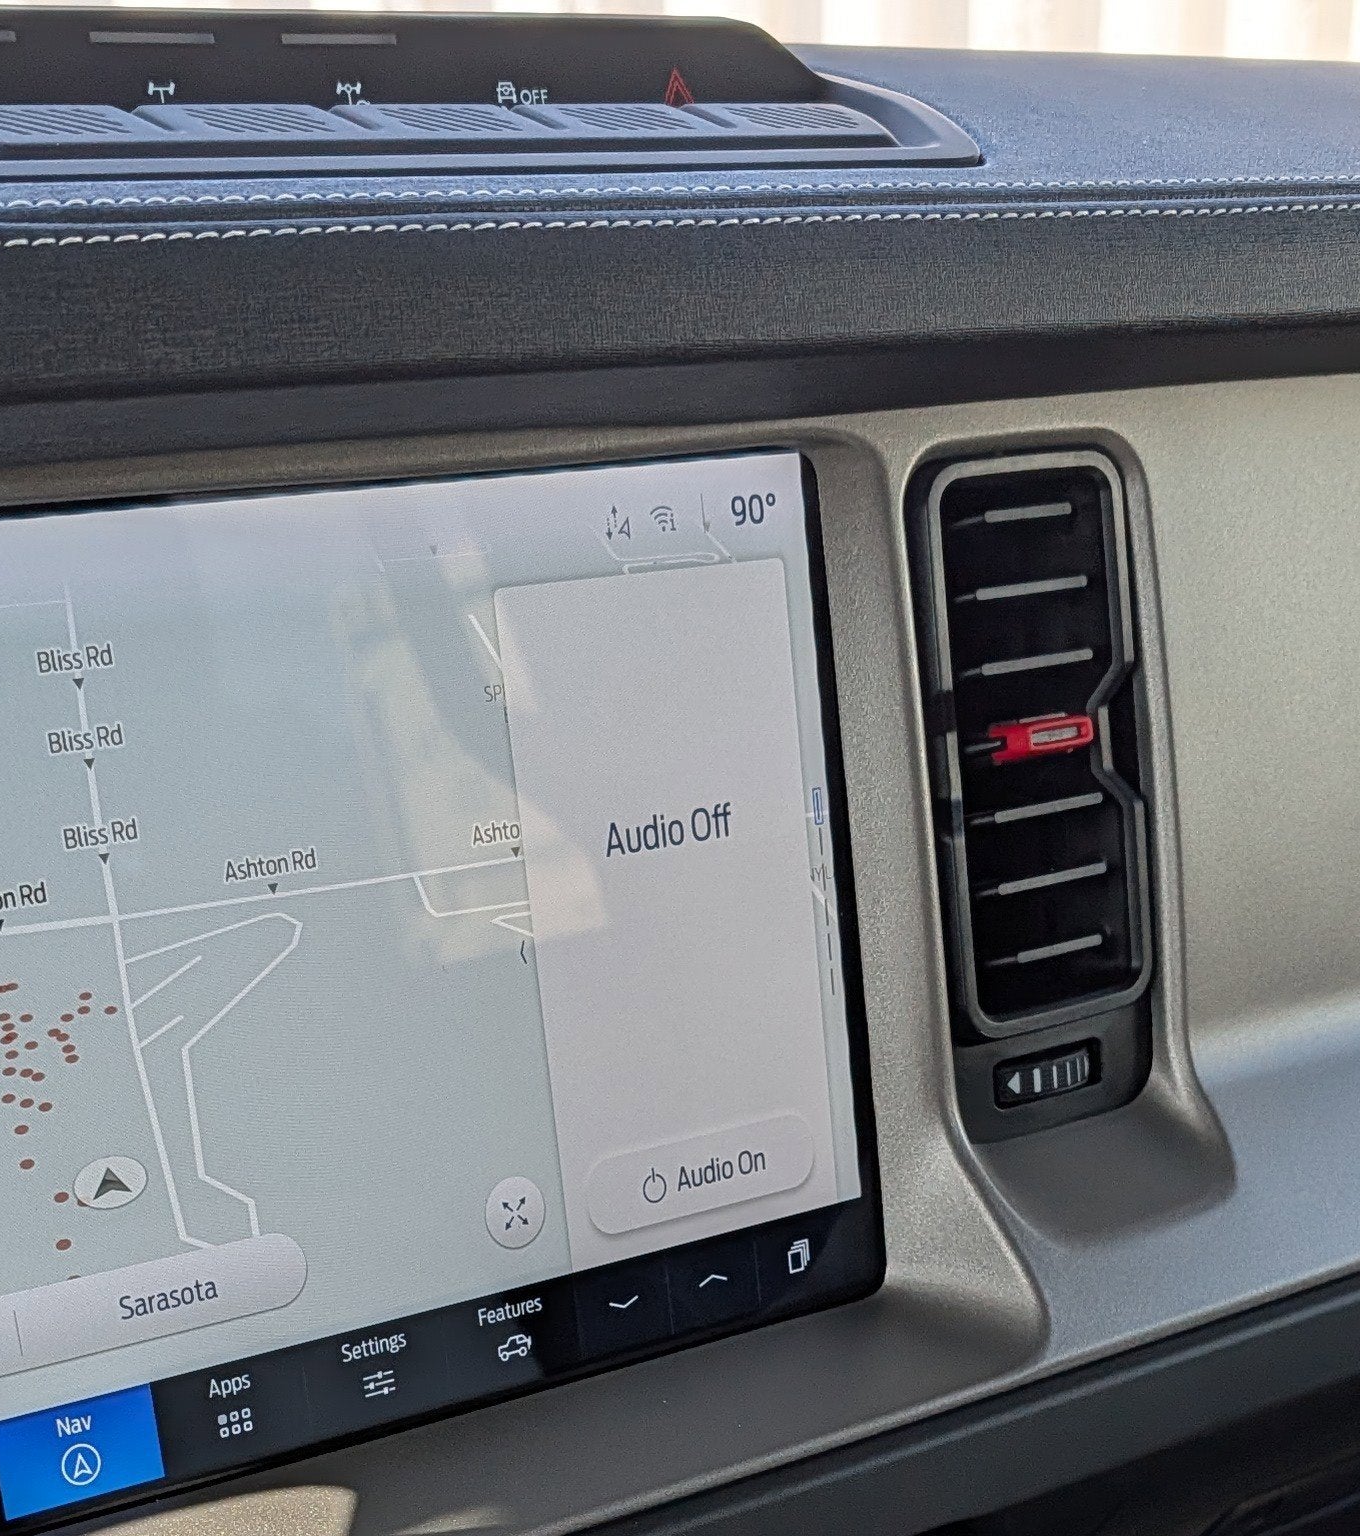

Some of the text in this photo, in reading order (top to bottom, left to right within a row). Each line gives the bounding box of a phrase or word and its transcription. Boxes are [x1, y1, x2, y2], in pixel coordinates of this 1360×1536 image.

[520, 89, 548, 105] OFF
[36, 643, 114, 674] Bliss Rd
[47, 723, 124, 754] Bliss Rd
[62, 818, 138, 850] Bliss Rd
[605, 801, 732, 858] Audio Off
[224, 847, 317, 882] Ashton Rd
[21, 881, 48, 908] Rd
[676, 1148, 767, 1192] Audio On
[118, 1278, 219, 1321] Sarasota
[477, 1296, 542, 1327] Features
[341, 1331, 407, 1364] Settings
[208, 1372, 251, 1399] Apps
[56, 1412, 92, 1437] Nav
